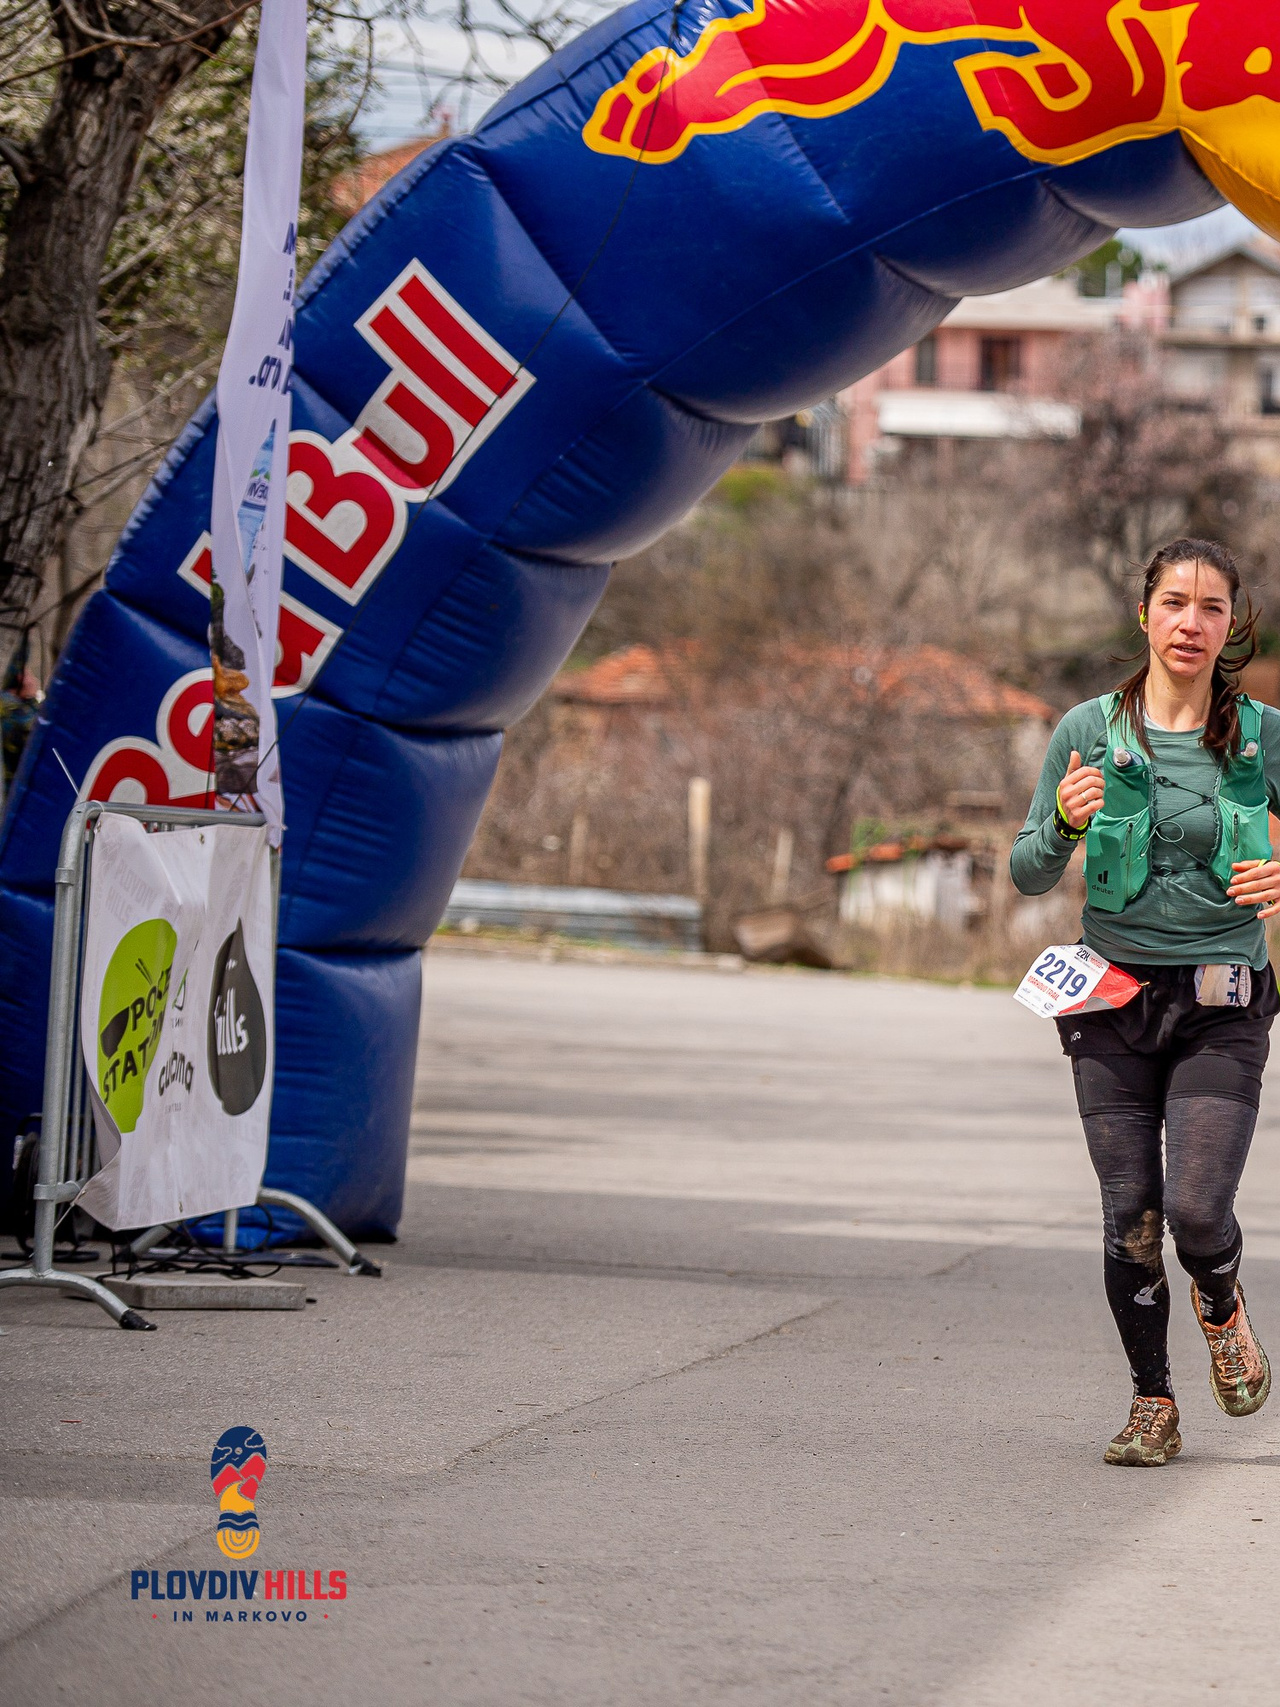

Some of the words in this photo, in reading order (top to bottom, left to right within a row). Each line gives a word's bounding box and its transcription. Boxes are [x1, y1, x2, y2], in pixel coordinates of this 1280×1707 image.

[284, 268, 522, 594] Bull
[1091, 884, 1115, 896] deuter
[1034, 952, 1088, 998] 2219
